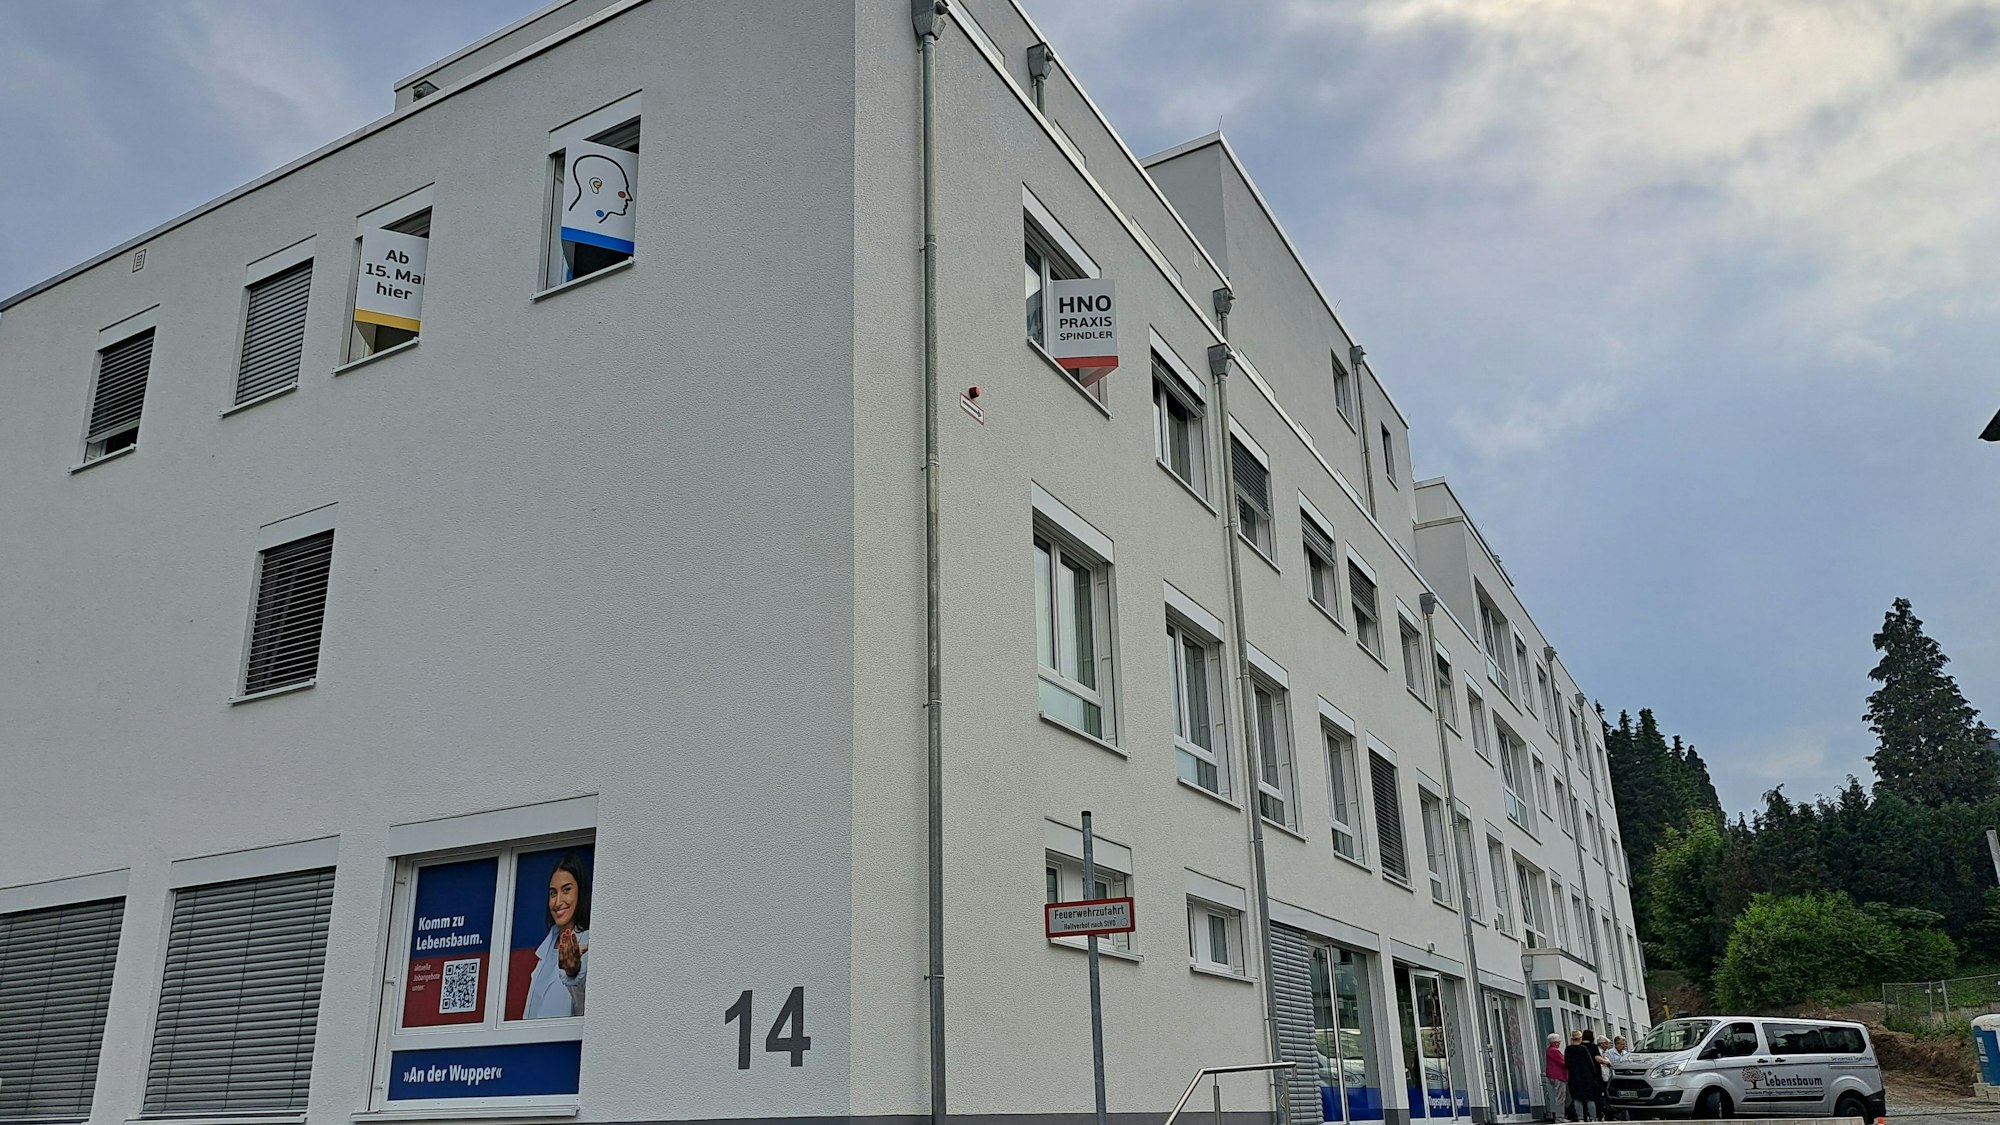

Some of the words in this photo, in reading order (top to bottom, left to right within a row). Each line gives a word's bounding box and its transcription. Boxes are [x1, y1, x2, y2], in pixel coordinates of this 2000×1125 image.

[385, 249, 409, 264] Ab
[365, 263, 391, 278] 15.
[395, 268, 426, 286] Mai
[376, 281, 413, 300] hier
[1059, 294, 1112, 314] HNO
[1060, 316, 1112, 328] PRAXIS
[1060, 331, 1113, 341] SPINDLER
[1054, 905, 1125, 920] Feuerwehrzufahrt
[418, 916, 450, 931] Komm
[452, 915, 465, 927] zu
[416, 932, 483, 951] Lebensbaum.
[724, 986, 811, 1070] 14
[427, 1064, 447, 1082] der
[1763, 1071, 1823, 1087] Lebensbaum
